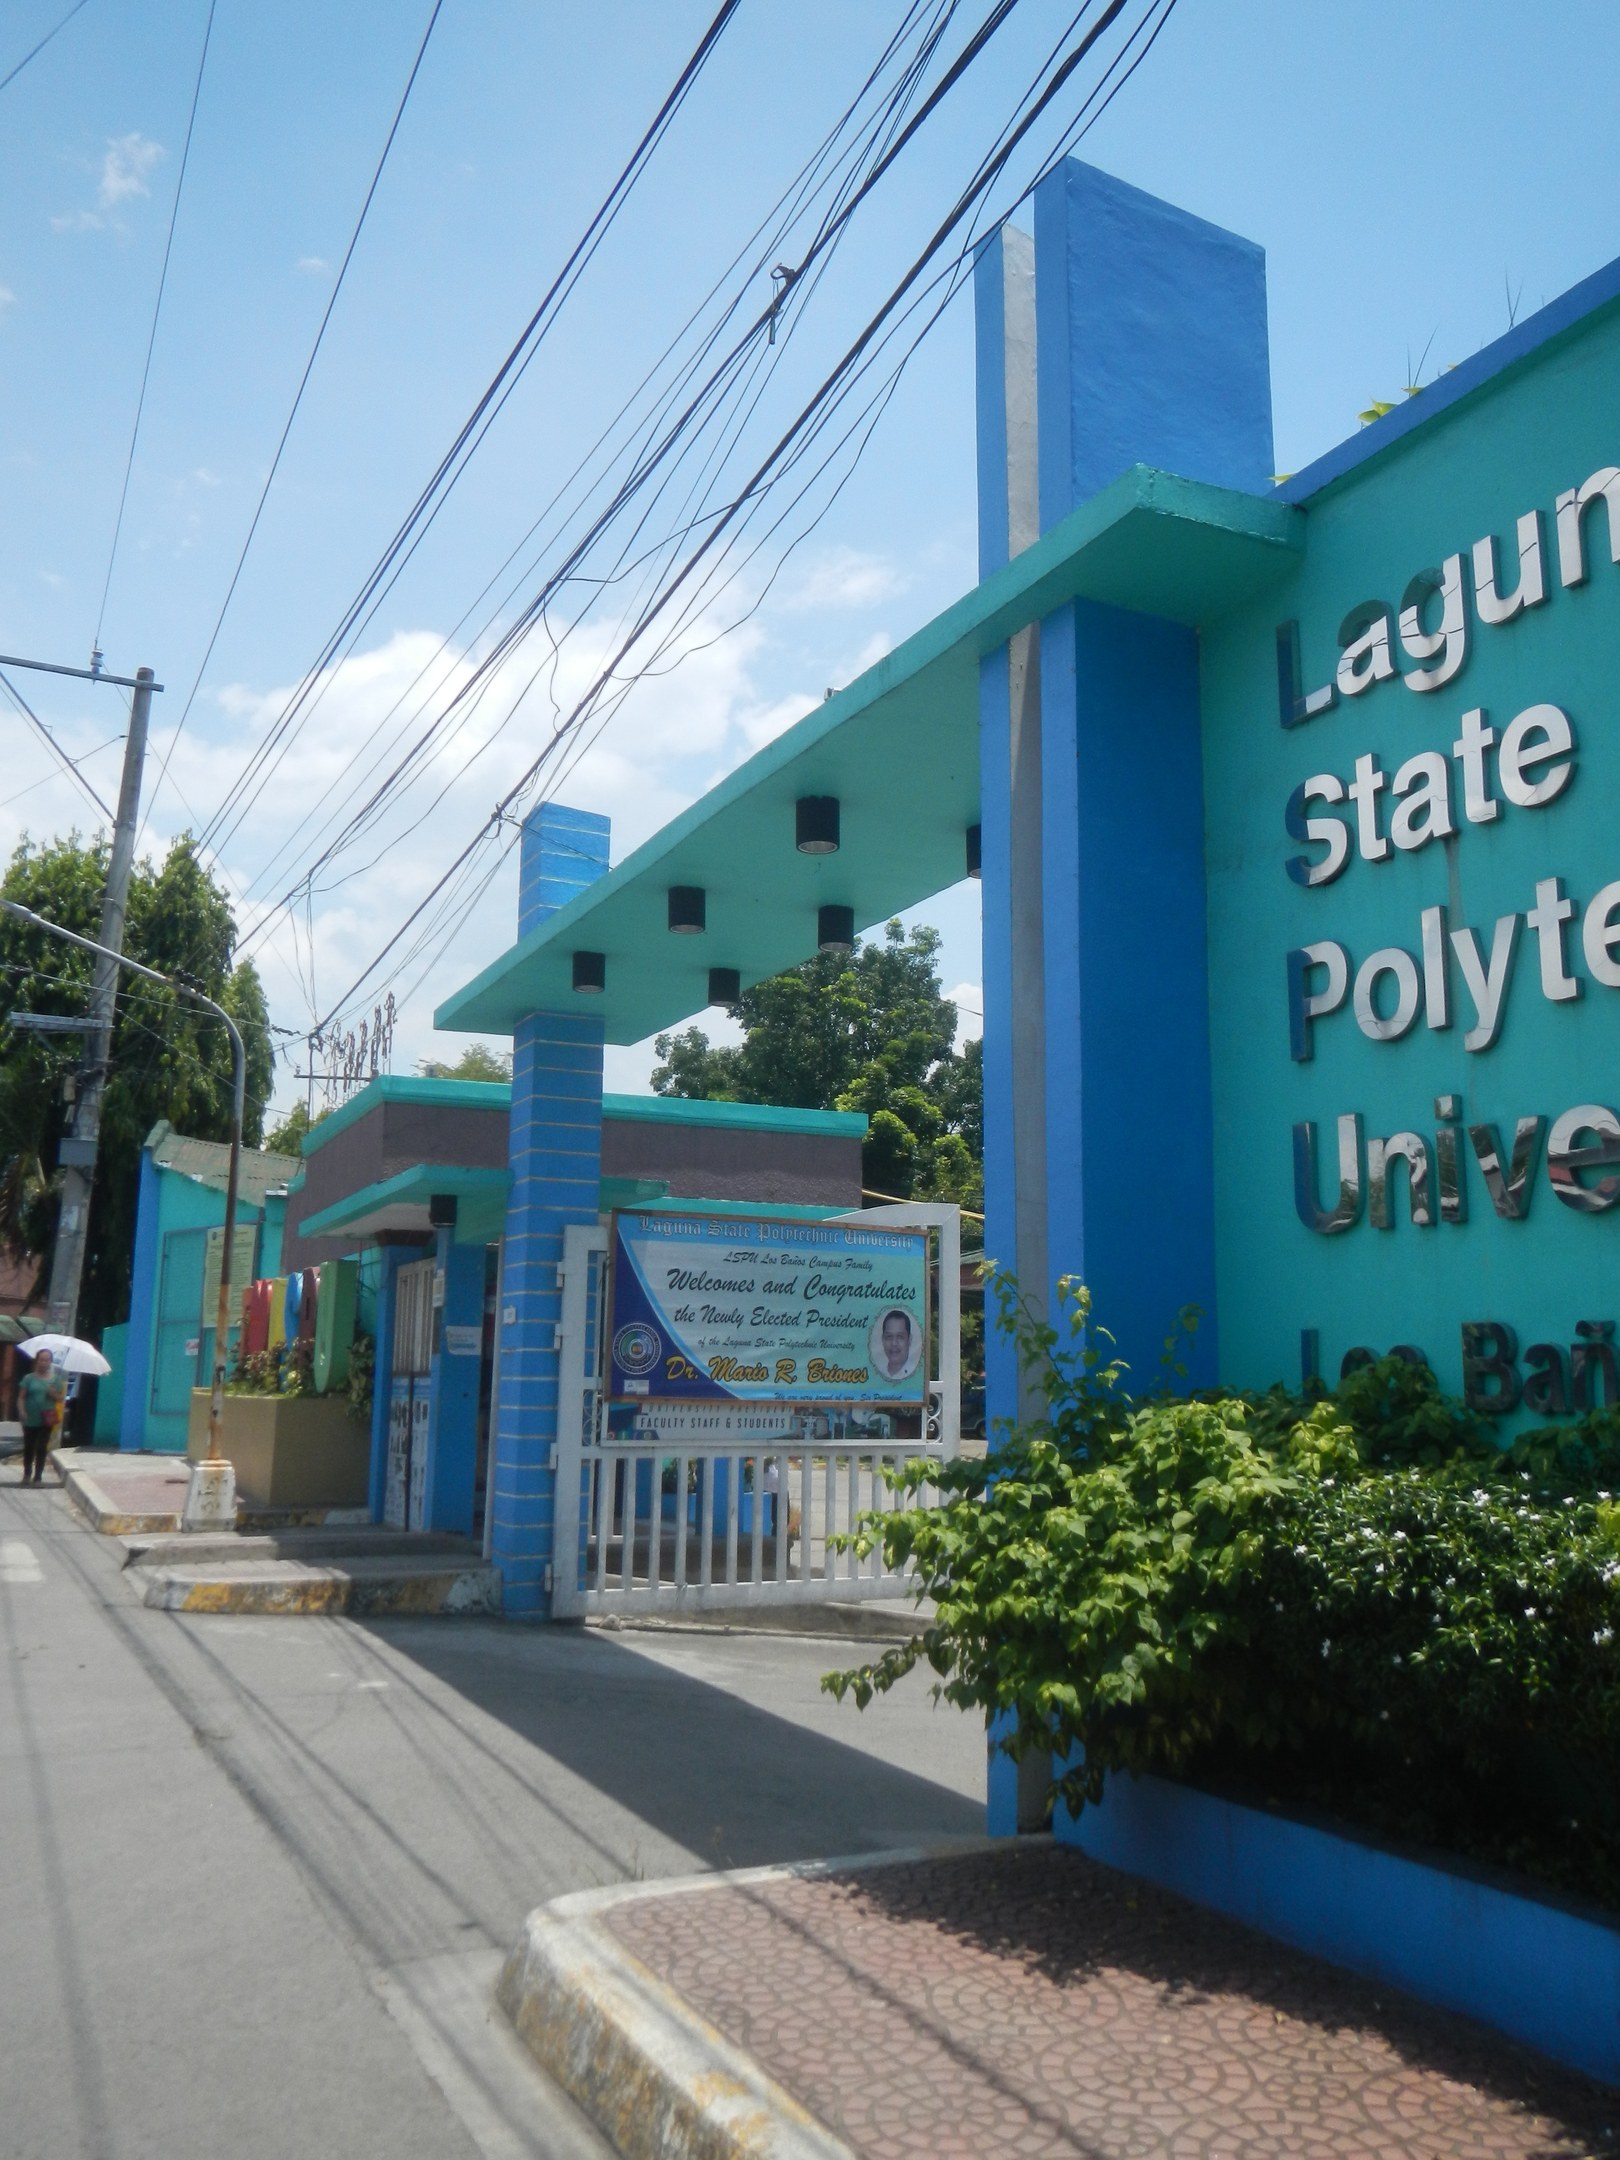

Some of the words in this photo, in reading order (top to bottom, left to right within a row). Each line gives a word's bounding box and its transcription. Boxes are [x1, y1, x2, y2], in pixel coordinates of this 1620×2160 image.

[1285, 703, 1577, 886] State
[1292, 1094, 1620, 1234] Unive
[640, 1215, 701, 1236] Laguna
[707, 1219, 751, 1238] State
[758, 1222, 839, 1244] Polytechnic
[844, 1229, 914, 1251] University
[722, 1251, 759, 1264] LSPU
[760, 1253, 778, 1265] Los
[780, 1253, 806, 1266] Baños
[808, 1255, 842, 1269] Campus
[845, 1258, 873, 1272] Family
[666, 1268, 756, 1293] Welcomes
[762, 1275, 798, 1295] and
[803, 1274, 917, 1304] Congratulates
[674, 1304, 696, 1322] the
[700, 1304, 745, 1329] Newly
[750, 1306, 802, 1326] Elected
[806, 1309, 869, 1329] President
[722, 1336, 752, 1349] Laguna
[754, 1337, 776, 1348] State
[820, 1339, 855, 1352] University
[666, 1355, 699, 1381] Dr.
[708, 1355, 770, 1382] Mario
[773, 1358, 797, 1385] R.
[807, 1357, 869, 1384] Briones
[640, 1417, 685, 1429] FACULTY
[690, 1417, 720, 1429] STAFF
[725, 1417, 732, 1429] &
[737, 1417, 785, 1429] STUDENTS
